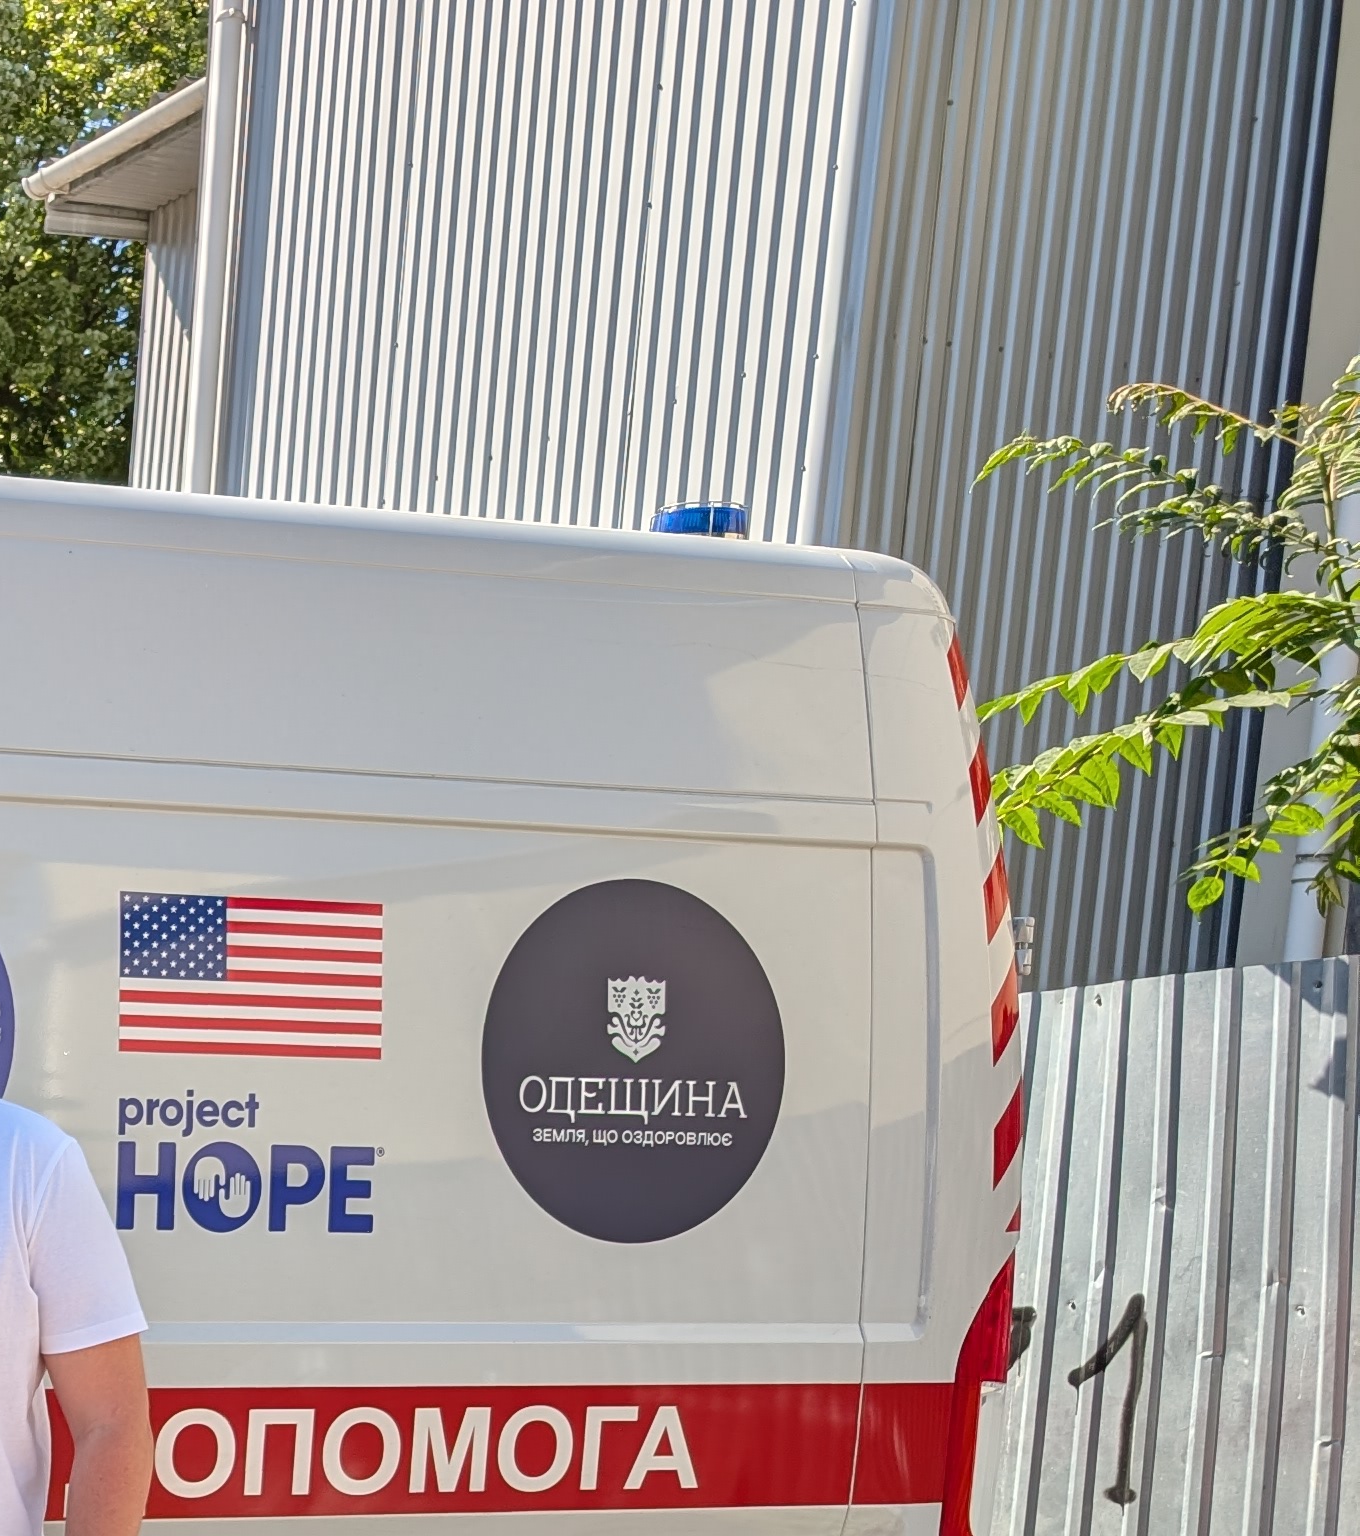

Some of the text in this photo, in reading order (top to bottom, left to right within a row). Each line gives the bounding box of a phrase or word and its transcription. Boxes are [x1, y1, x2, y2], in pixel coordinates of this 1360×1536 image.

[118, 1089, 260, 1138] project
[519, 1075, 748, 1126] ОДЕЩИНА
[532, 1127, 733, 1148] ЗЕМЛЯ, ЩО ОЗДОРОВЛЮЄ
[64, 1405, 699, 1518] ОПОМОГА
